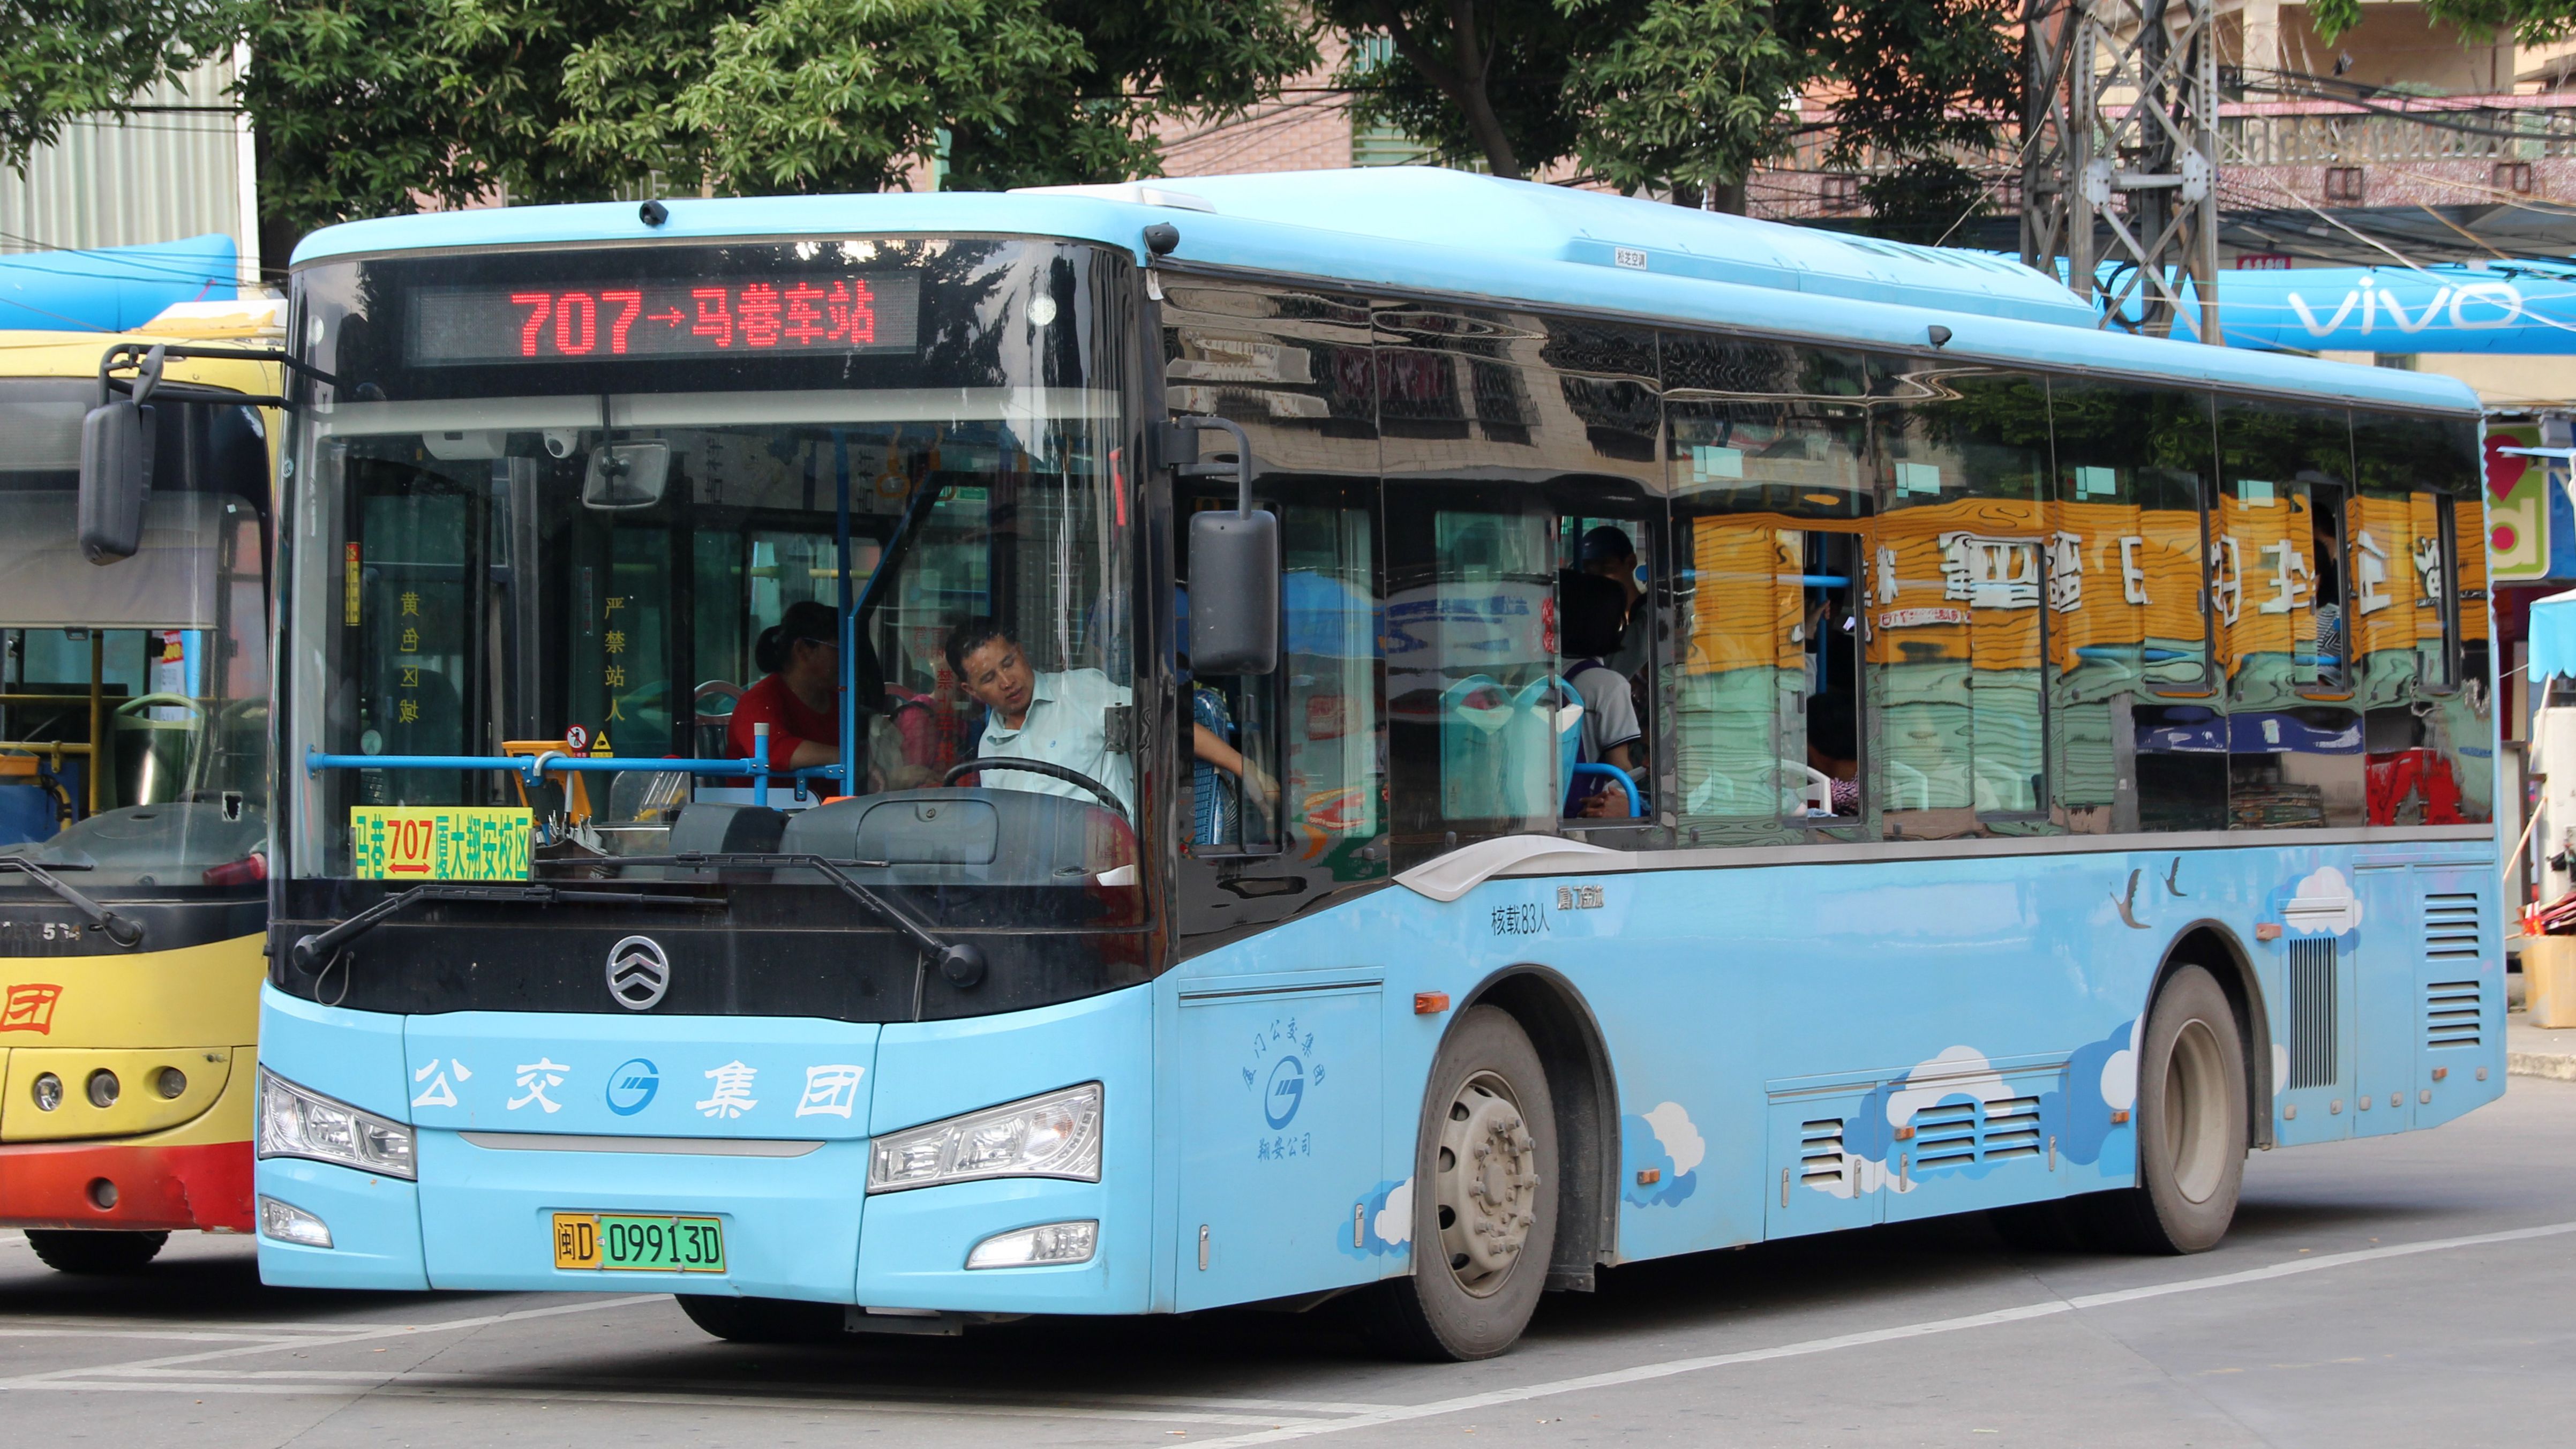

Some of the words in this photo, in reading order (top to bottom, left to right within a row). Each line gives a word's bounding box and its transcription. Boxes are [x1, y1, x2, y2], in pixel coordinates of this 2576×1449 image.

[1617, 249, 1646, 268] 松芝空调
[511, 290, 642, 357] 707
[691, 279, 874, 347] 马巷车站
[2288, 275, 2523, 337] vivo
[604, 597, 626, 722] 严禁站人
[355, 814, 386, 880] 马巷
[388, 820, 433, 860] 707
[435, 814, 529, 880] 厦大翔安校区
[1491, 903, 1550, 936] 核载83人
[1242, 1017, 1325, 1092] 厦门公交集团
[411, 1057, 570, 1114] 公交
[695, 1060, 865, 1119] 集团
[1257, 1132, 1311, 1162] 翔安公司
[558, 1221, 594, 1260] 闽D
[610, 1223, 720, 1264] 09913D
